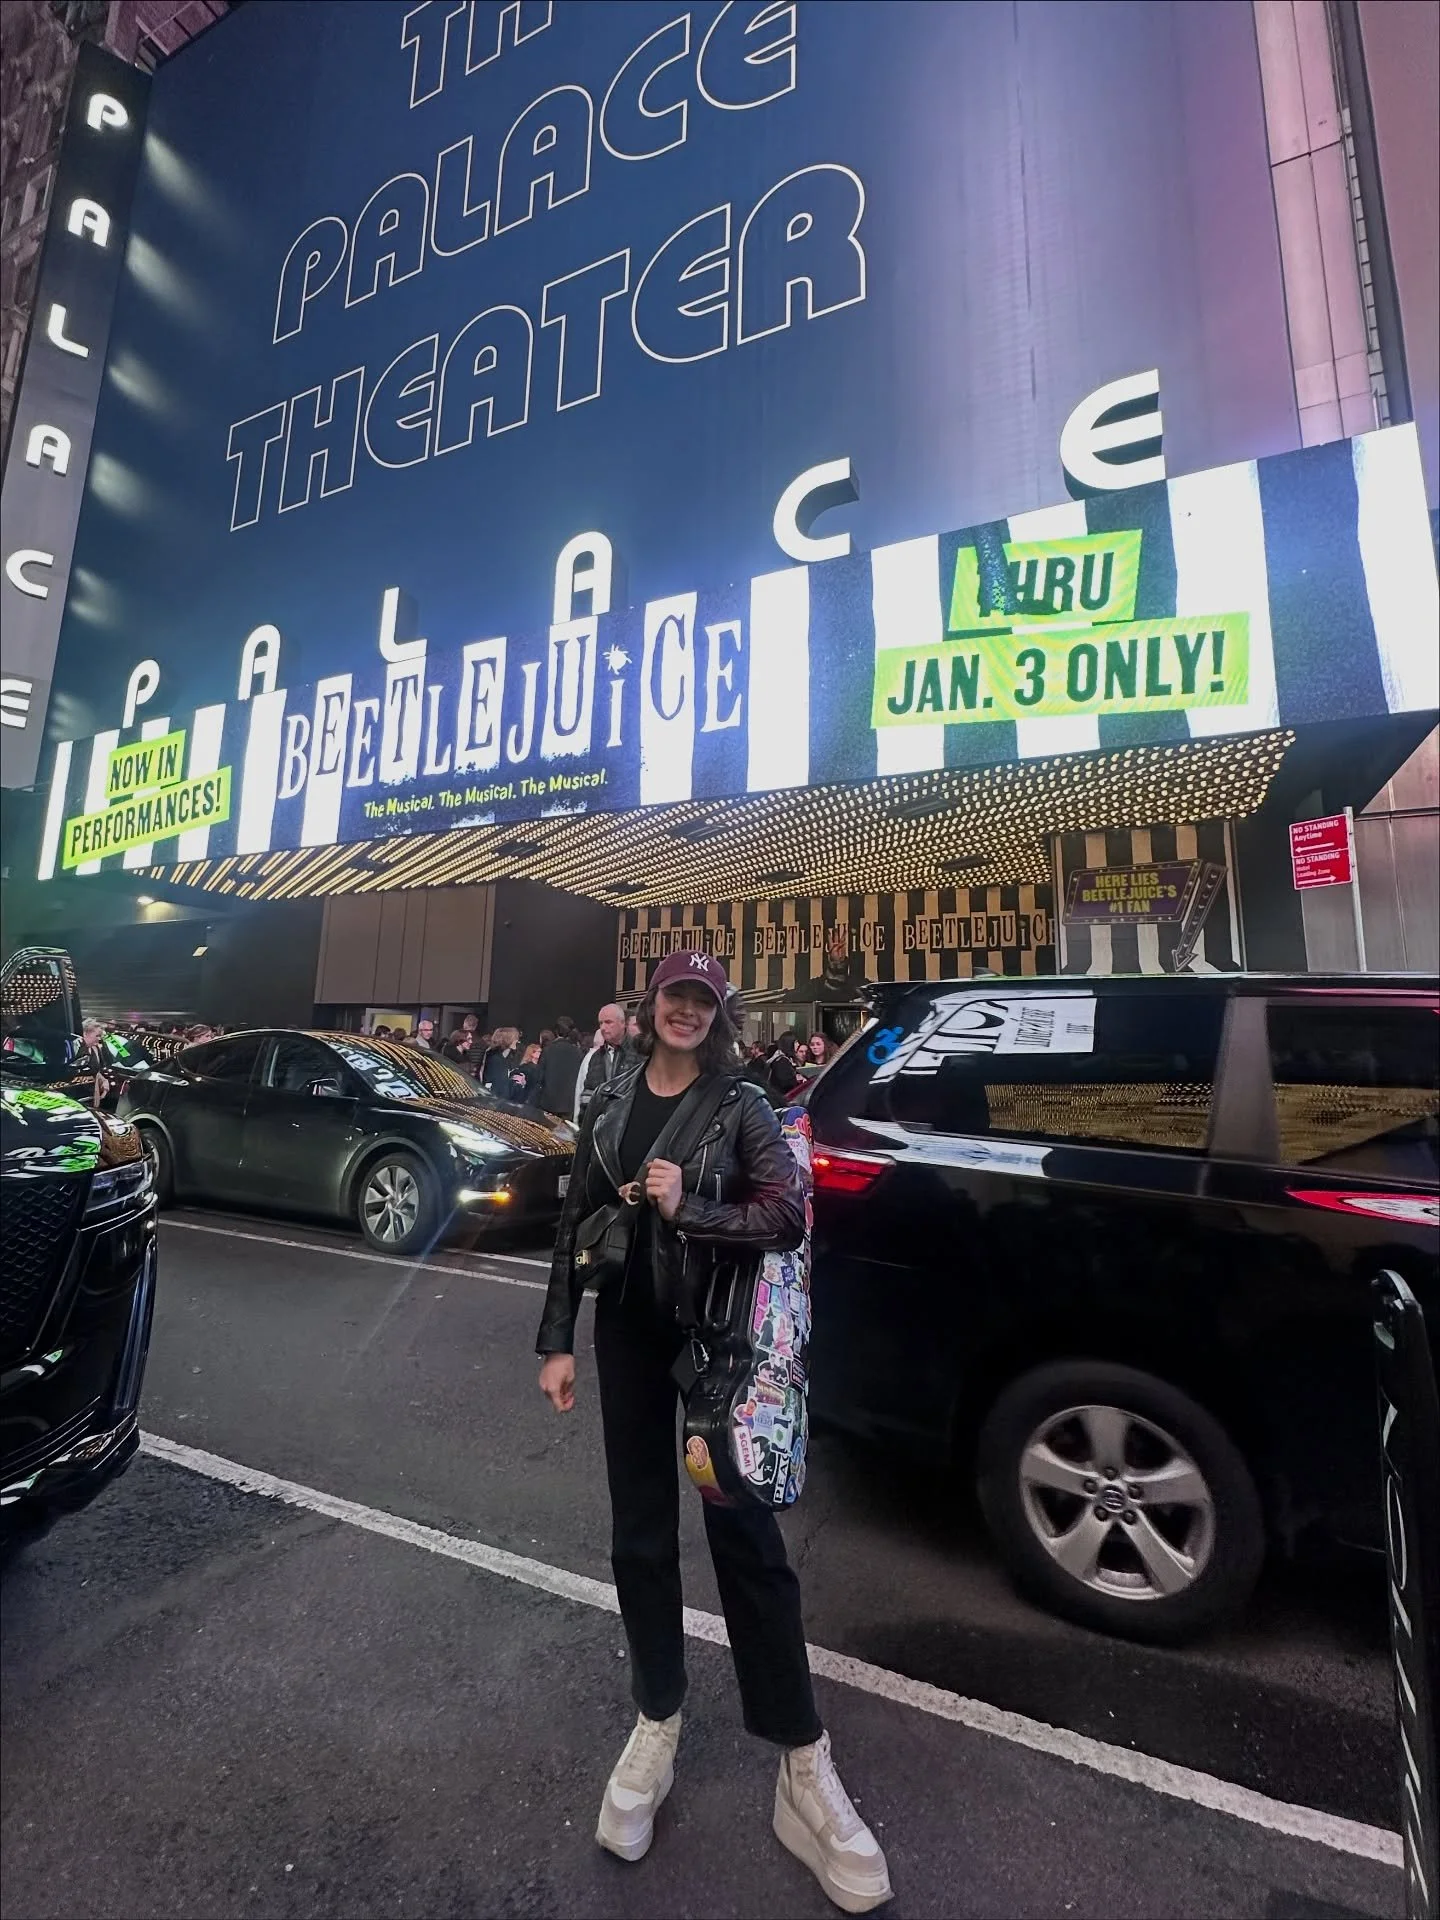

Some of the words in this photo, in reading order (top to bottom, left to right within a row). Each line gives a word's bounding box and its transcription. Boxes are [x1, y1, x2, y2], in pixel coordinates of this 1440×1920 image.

[273, 0, 796, 344] PALACE
[226, 163, 866, 532] THEATER
[122, 369, 1167, 729] PALACE
[976, 551, 1115, 618] HRU
[887, 654, 993, 715] JAN.
[1013, 647, 1046, 705] 3
[1066, 629, 1226, 702] ONLY!
[109, 749, 154, 792] NOW
[157, 743, 179, 780] IN
[71, 777, 222, 858] PERFORMANCES!
[364, 801, 385, 818] The
[387, 794, 435, 815] Musical.
[438, 790, 462, 808] The
[465, 784, 517, 805] Musical.
[520, 777, 546, 796] The
[549, 768, 608, 792] Musical.
[1292, 826, 1304, 834] NO
[1304, 819, 1339, 832] STANDING
[1293, 831, 1323, 842] Anytime
[1095, 874, 1129, 888] HERE
[1130, 872, 1160, 886] LIES
[1306, 851, 1340, 864] STANDING
[1082, 885, 1178, 902] BEETLEJUICE'S
[1108, 901, 1124, 913] #1
[1126, 900, 1151, 913] FAN
